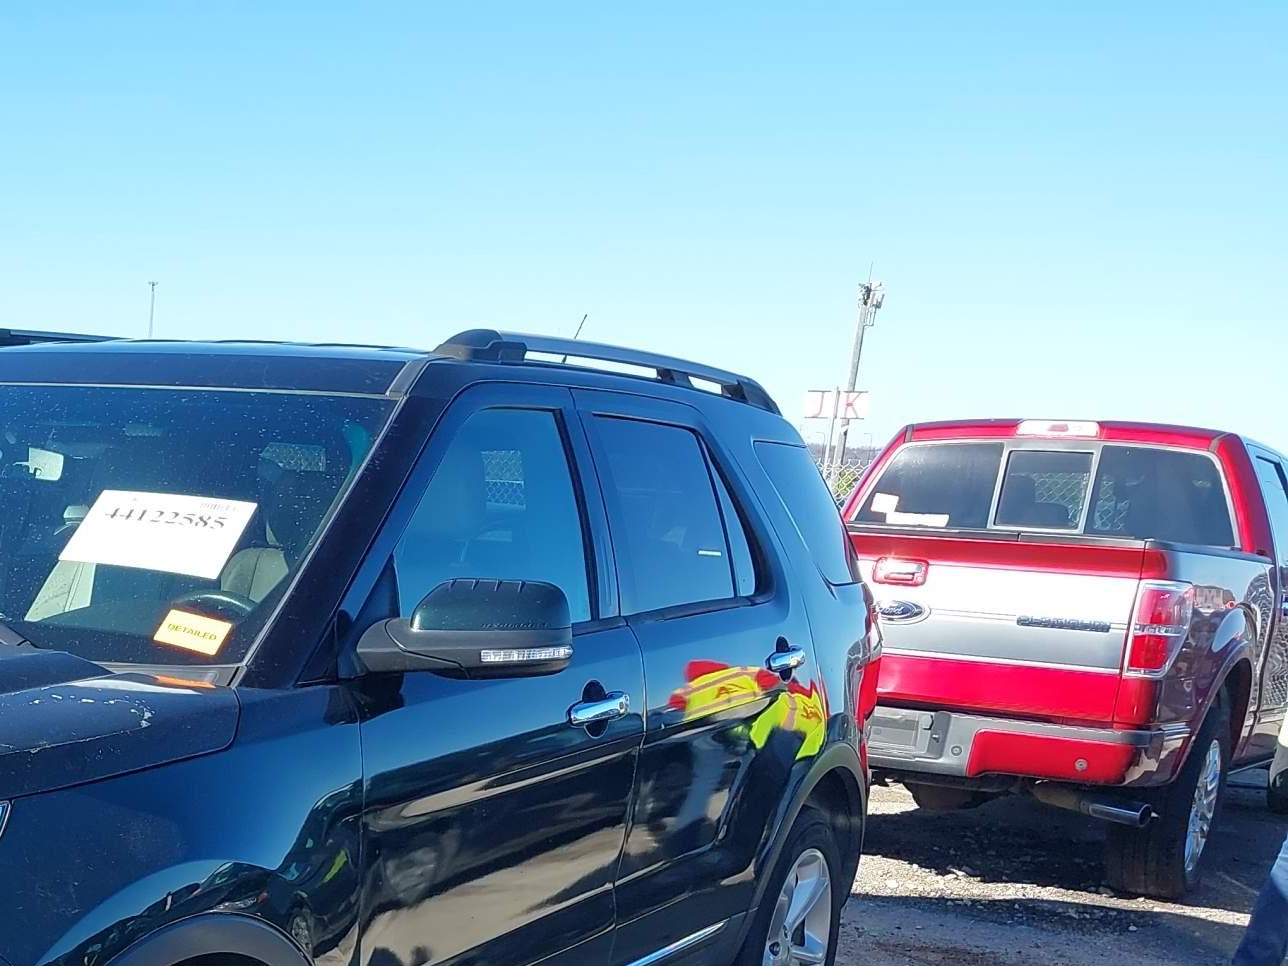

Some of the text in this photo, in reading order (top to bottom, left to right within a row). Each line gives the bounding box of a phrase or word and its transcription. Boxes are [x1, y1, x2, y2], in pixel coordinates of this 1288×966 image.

[843, 391, 863, 419] K
[105, 507, 228, 528] 44122585
[168, 623, 217, 641] DETAILED
